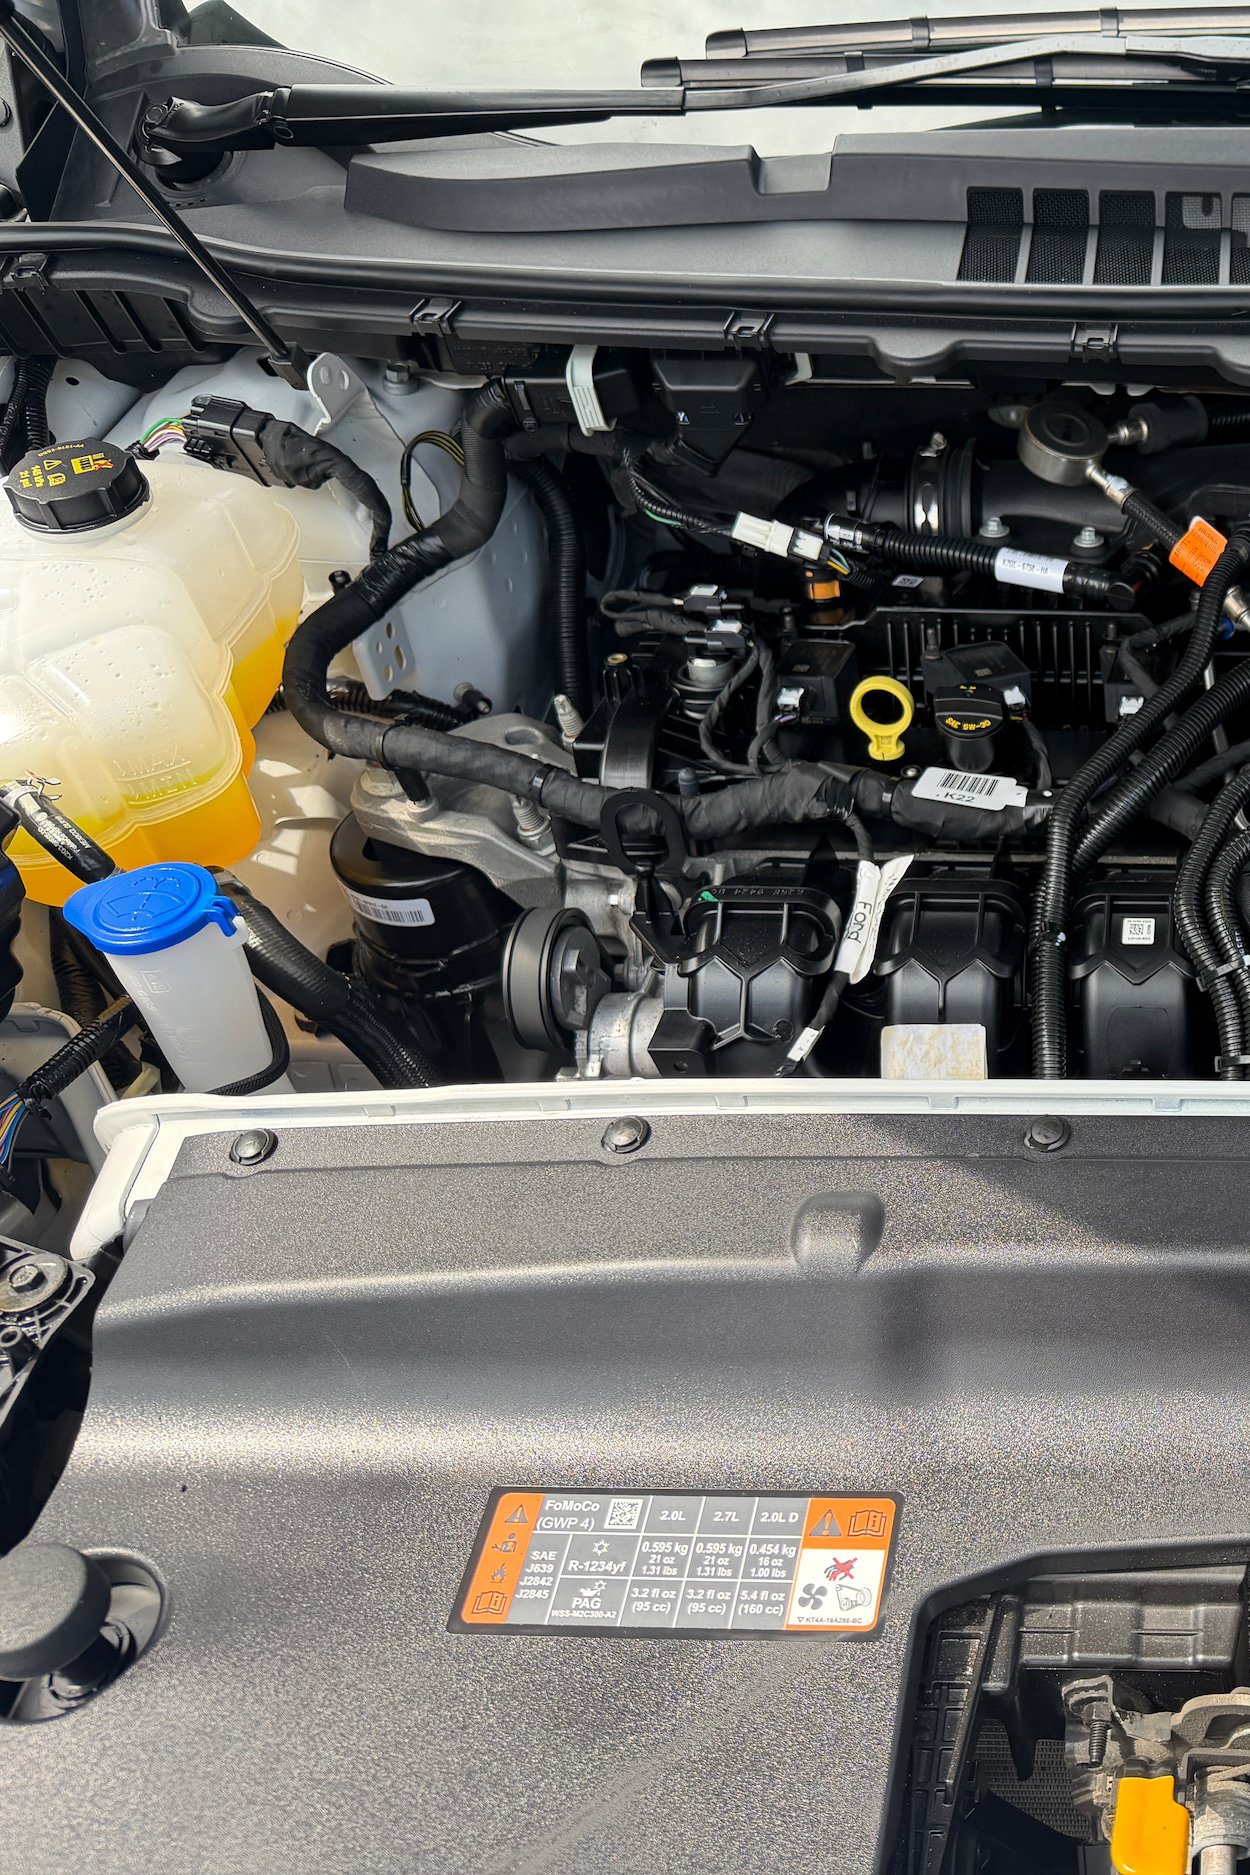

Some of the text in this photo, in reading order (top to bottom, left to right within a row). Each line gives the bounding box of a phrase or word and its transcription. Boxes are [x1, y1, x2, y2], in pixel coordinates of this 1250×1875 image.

[945, 717, 992, 730] SAE 5W-30
[847, 901, 872, 944] Ford
[545, 1500, 600, 1512] FoMoCo
[660, 1511, 686, 1520] 2.0L
[713, 1512, 740, 1522] 2.7L
[760, 1512, 798, 1522] 2.0L D
[536, 1517, 594, 1532] (GWP 4)
[642, 1542, 688, 1556] 0.595 kg
[696, 1542, 743, 1556] 0.595 kg
[750, 1544, 796, 1558] 0.454 kg
[531, 1550, 558, 1560] SAE
[648, 1554, 675, 1564] 21 oz
[704, 1556, 730, 1565] 21 oz
[758, 1556, 784, 1566] 16 oz
[526, 1564, 554, 1574] J639
[568, 1560, 628, 1574] R-1234yf
[641, 1566, 678, 1576] 1.31 lbs
[696, 1566, 732, 1576] 1.31 lbs
[750, 1568, 786, 1578] 1.00 lbs
[520, 1576, 554, 1586] J2842
[515, 1589, 550, 1599] J2845
[631, 1588, 676, 1598] 3.2 fl oz
[686, 1589, 732, 1600] 3.2 fl oz
[740, 1590, 785, 1600] 5.4 fl oz
[572, 1597, 602, 1609] PAG
[632, 1602, 671, 1614] (95 cc)
[688, 1602, 726, 1614] (95 cc)
[738, 1604, 784, 1616] (160 cc)
